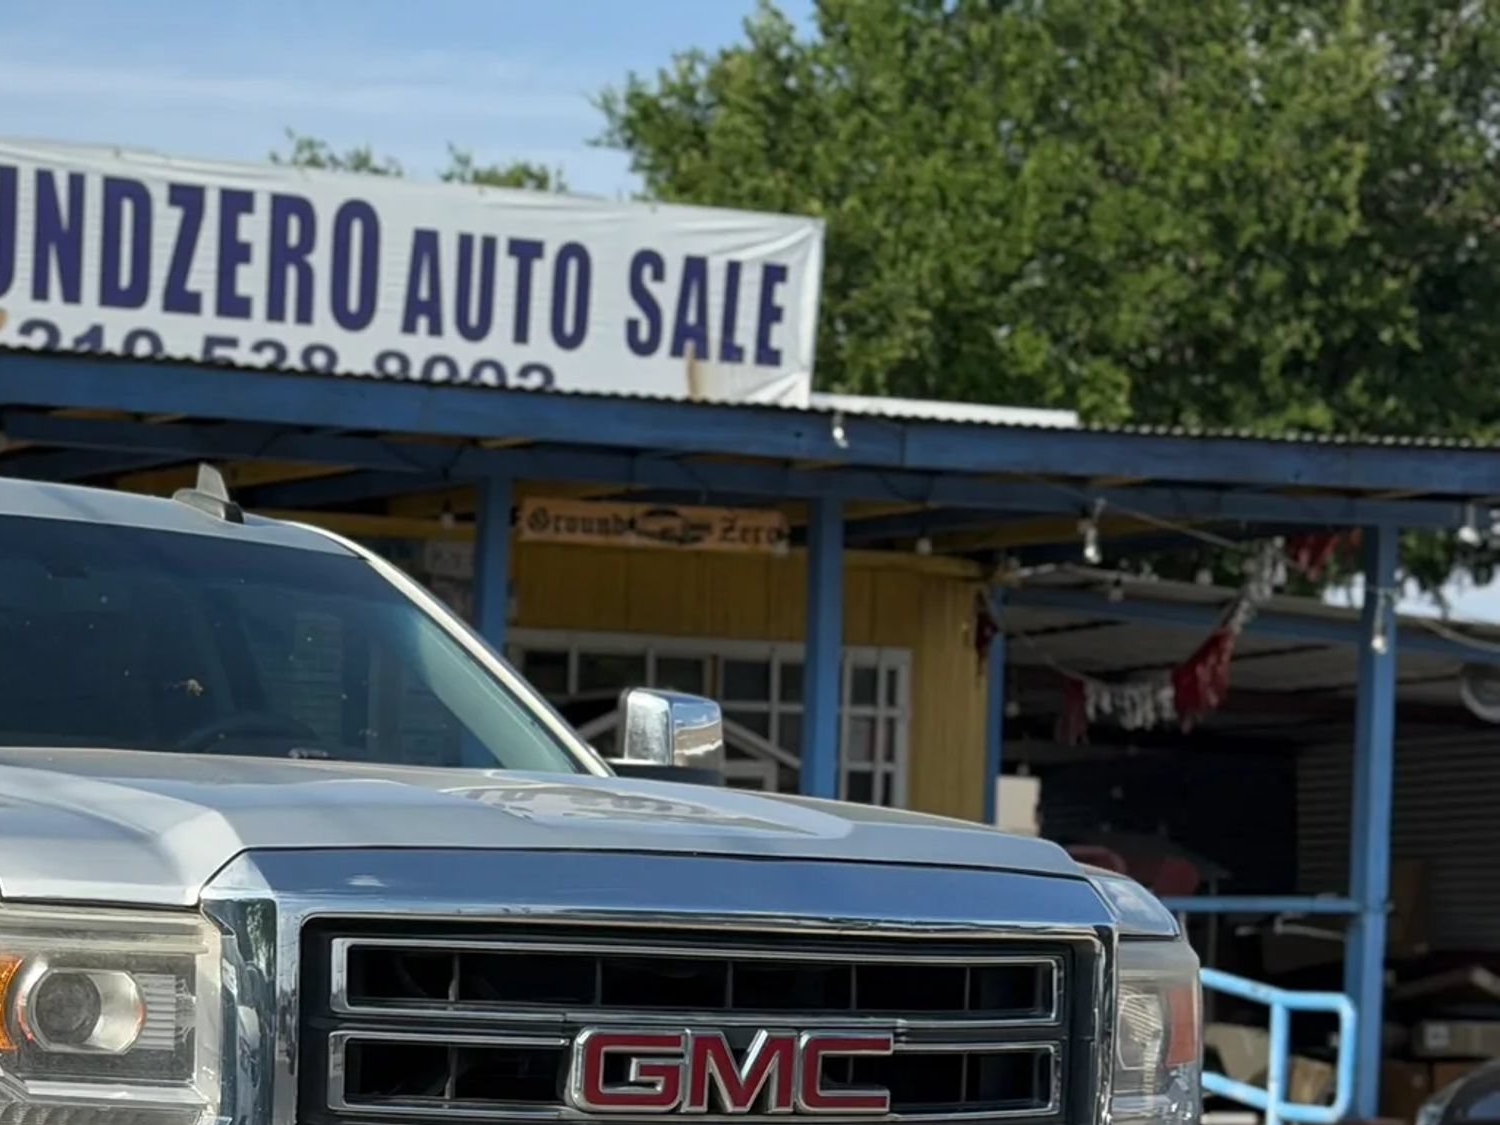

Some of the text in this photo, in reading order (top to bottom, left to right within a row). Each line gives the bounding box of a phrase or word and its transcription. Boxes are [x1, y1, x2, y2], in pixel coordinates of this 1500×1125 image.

[401, 228, 591, 351] AUTO
[625, 248, 788, 367] SALE
[570, 1026, 894, 1113] GMC
